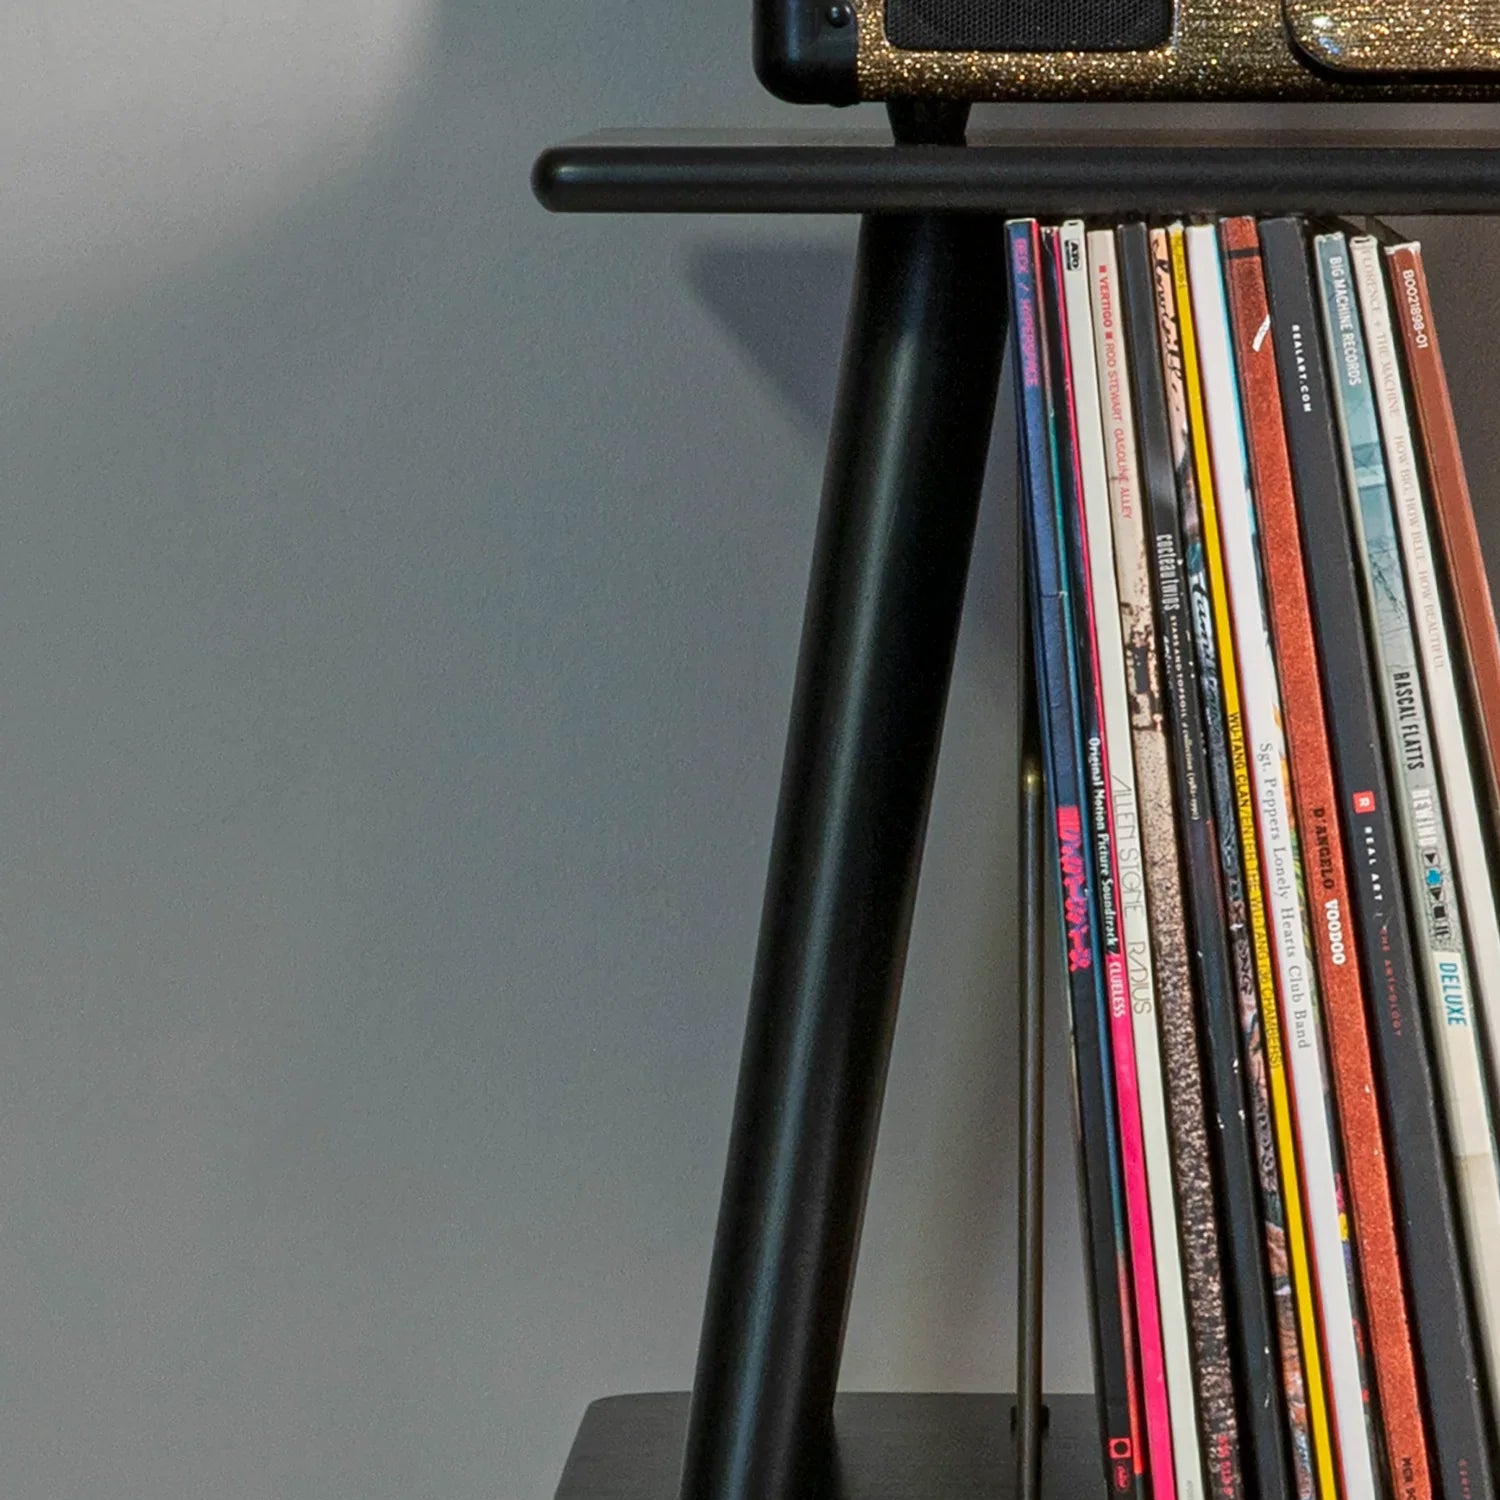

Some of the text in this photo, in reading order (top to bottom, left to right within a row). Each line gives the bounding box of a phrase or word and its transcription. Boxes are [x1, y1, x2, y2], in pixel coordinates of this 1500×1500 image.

[1360, 250, 1382, 313] FLORENCE
[1328, 256, 1362, 386] BIG MACHINE RECORDS
[1374, 334, 1388, 358] THE
[1098, 276, 1132, 520] VERTIGO ROD STEWART GASOLINE ALLEY
[1292, 324, 1312, 412] REALART.COM
[1379, 361, 1400, 418] MACHINE
[1392, 435, 1408, 464] HOW
[1404, 500, 1420, 530] HOW
[1416, 570, 1432, 601] HOW
[1170, 615, 1180, 646] STARS
[1174, 650, 1182, 671] AND
[1422, 604, 1444, 672] BEAUTIFUL
[1176, 674, 1188, 718] TOPSOIL
[1088, 738, 1104, 785] Original
[1228, 712, 1246, 770] WU-TANG
[1392, 672, 1436, 847] RASCAL FLATTS REWIND
[1094, 790, 1108, 830] Motion
[1096, 833, 1110, 874] Picture
[1111, 774, 1144, 918] ALLEN STONE
[1364, 826, 1376, 865] REAL
[1371, 874, 1382, 900] ART
[1102, 878, 1119, 946] Soundtrack
[1256, 743, 1310, 1049] Sgt. Peppers Lonely Hearts Club Band
[1312, 808, 1346, 965] D'ANGELO VOODOO
[1108, 962, 1125, 1018] CLUELESS
[1128, 942, 1151, 1014] RADIUS
[1438, 962, 1467, 1026] DELUXE
